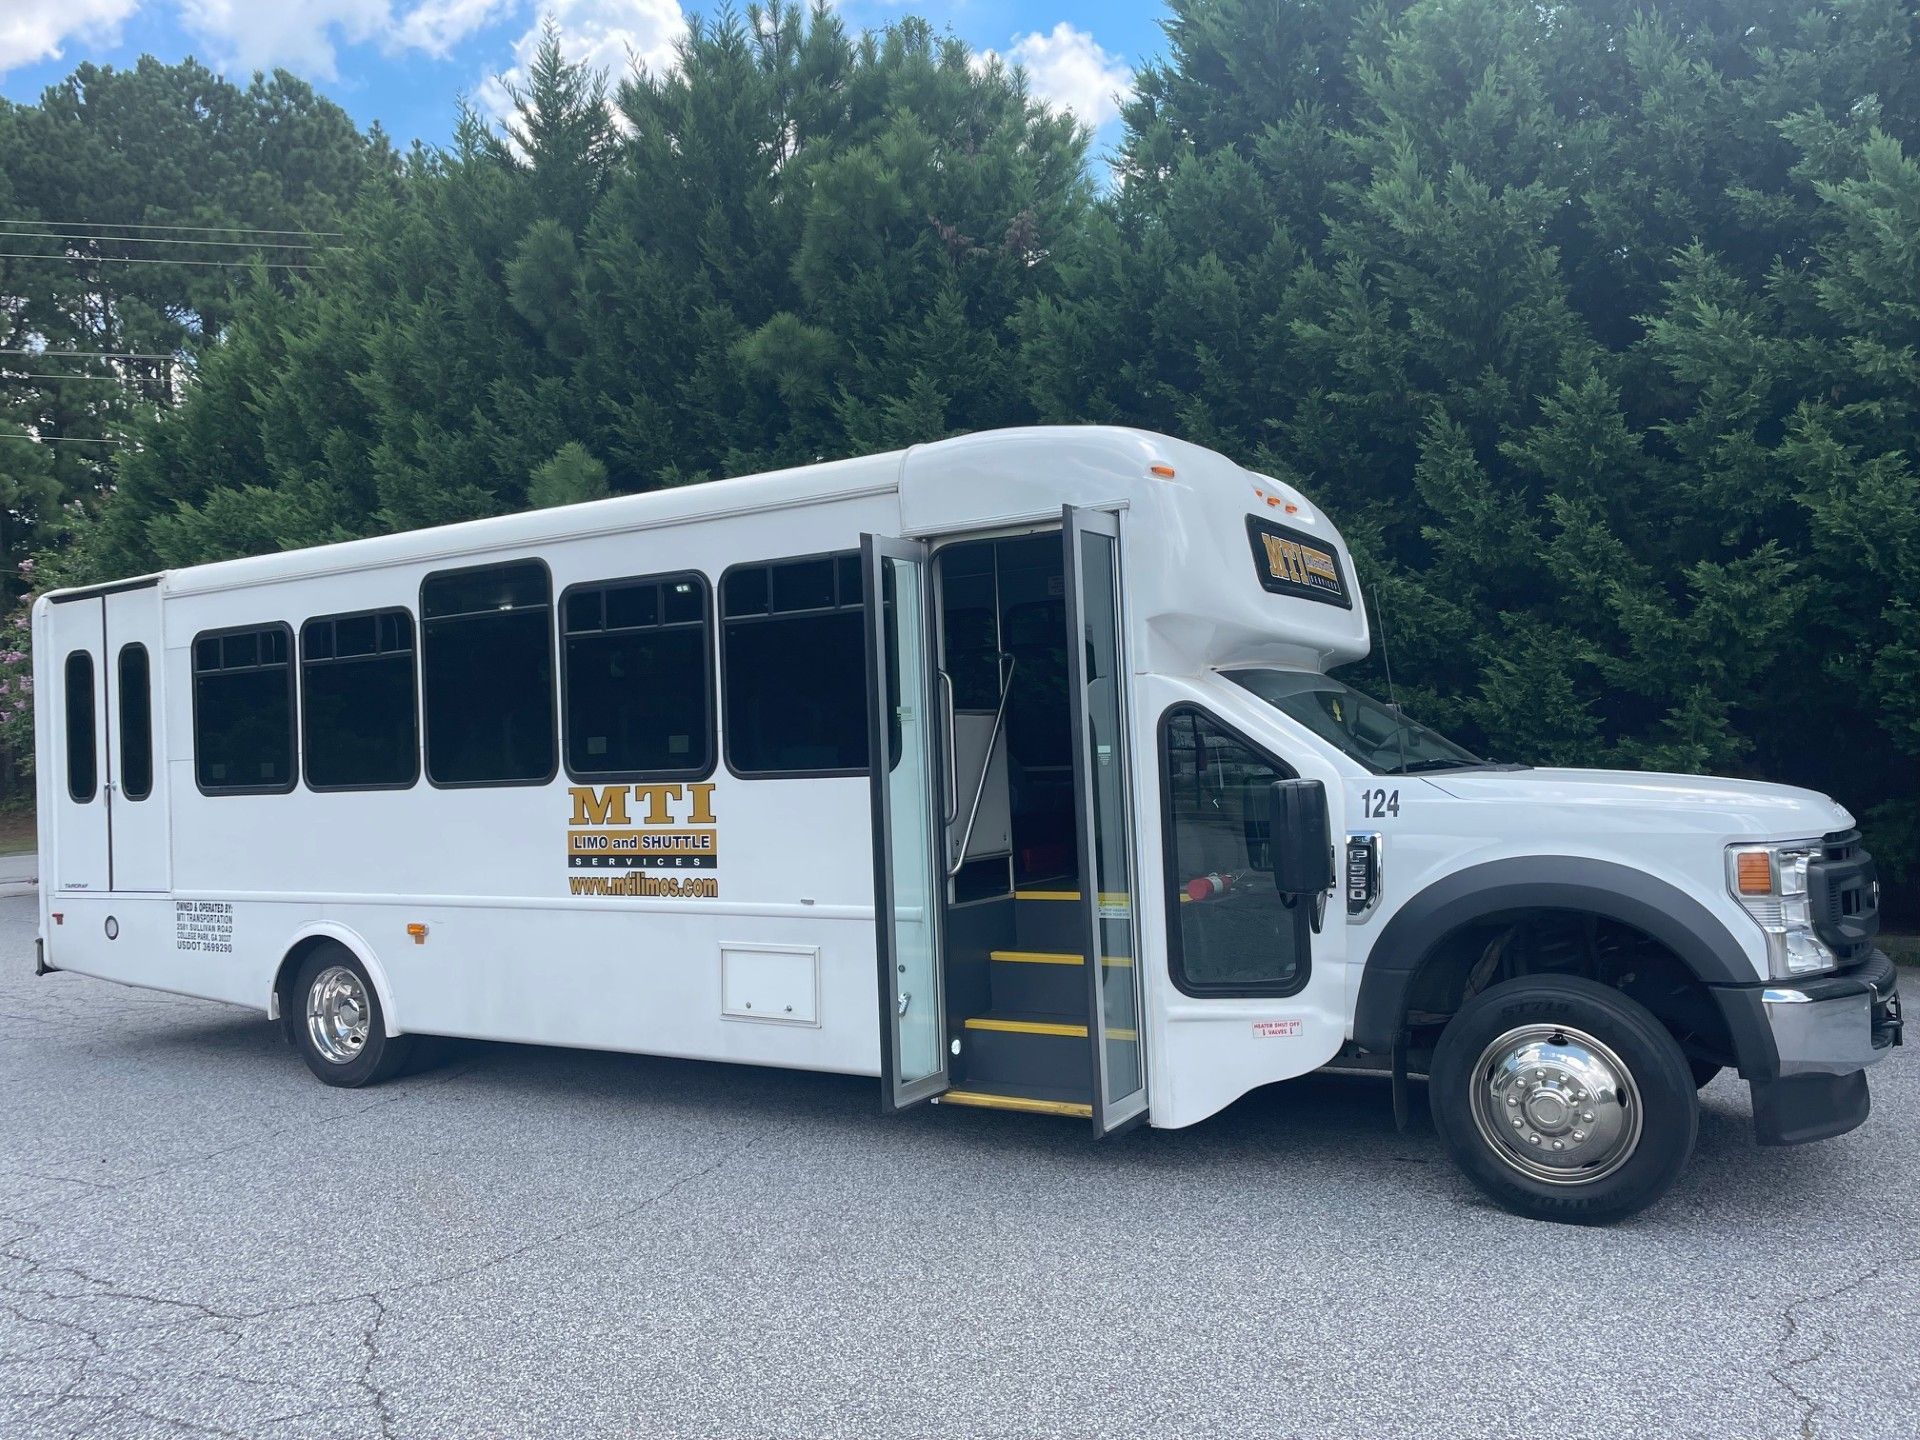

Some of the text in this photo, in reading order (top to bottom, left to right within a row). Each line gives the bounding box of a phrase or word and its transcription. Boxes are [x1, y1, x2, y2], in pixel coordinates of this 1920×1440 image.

[1261, 532, 1309, 585] MTI
[568, 783, 716, 825] MTI
[1361, 788, 1400, 818] 124
[573, 835, 710, 849] LIMO and SHUTTLE
[575, 857, 701, 866] SERVICES
[568, 871, 719, 898] www.mtilimos.com
[176, 902, 193, 911] OWNED
[199, 902, 224, 913] OPERATED
[176, 912, 232, 924] MTI TRANSPORTATION
[190, 923, 215, 932] SULLIVAN
[217, 924, 233, 933] ROAD
[176, 931, 196, 940] COLLEGE
[211, 933, 217, 941] GA
[176, 940, 201, 950] USDOT
